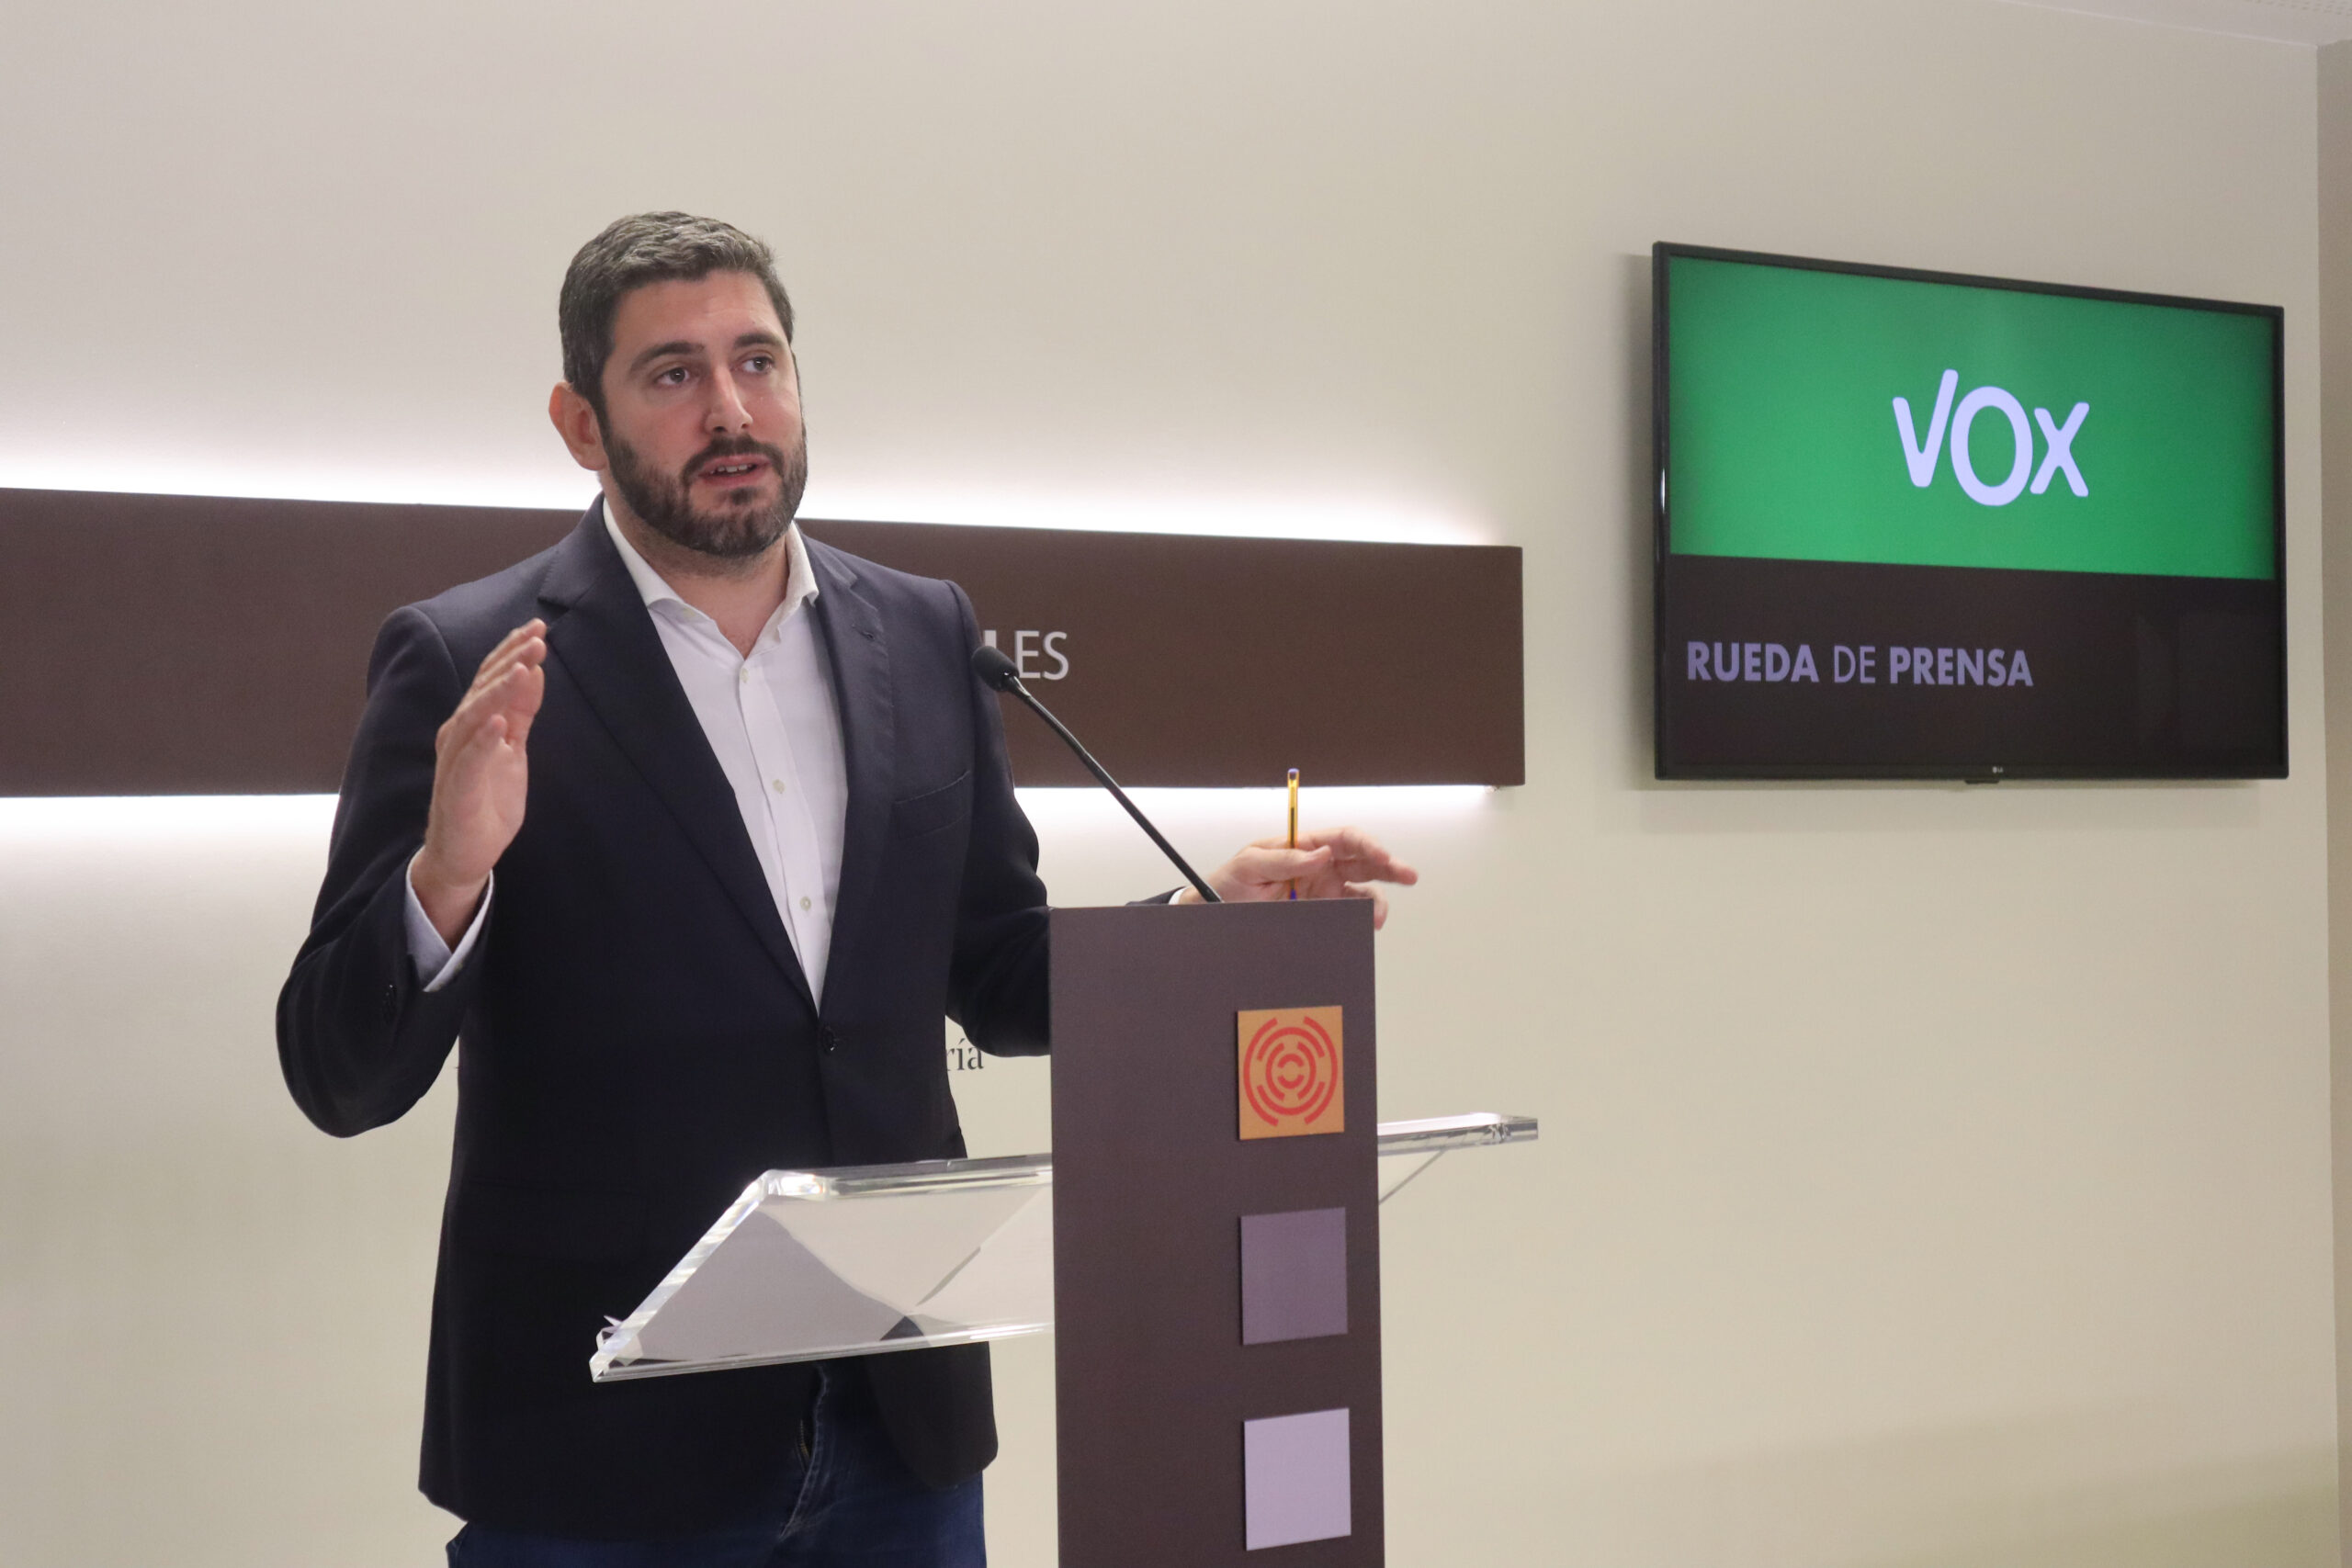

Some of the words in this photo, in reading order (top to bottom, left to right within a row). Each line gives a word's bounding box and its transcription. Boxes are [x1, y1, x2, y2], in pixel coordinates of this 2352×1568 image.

[1893, 369, 2090, 506] VOX
[1688, 641, 1819, 682] RUEDA
[1834, 645, 1876, 683] DE
[1890, 647, 2034, 687] PRENSA
